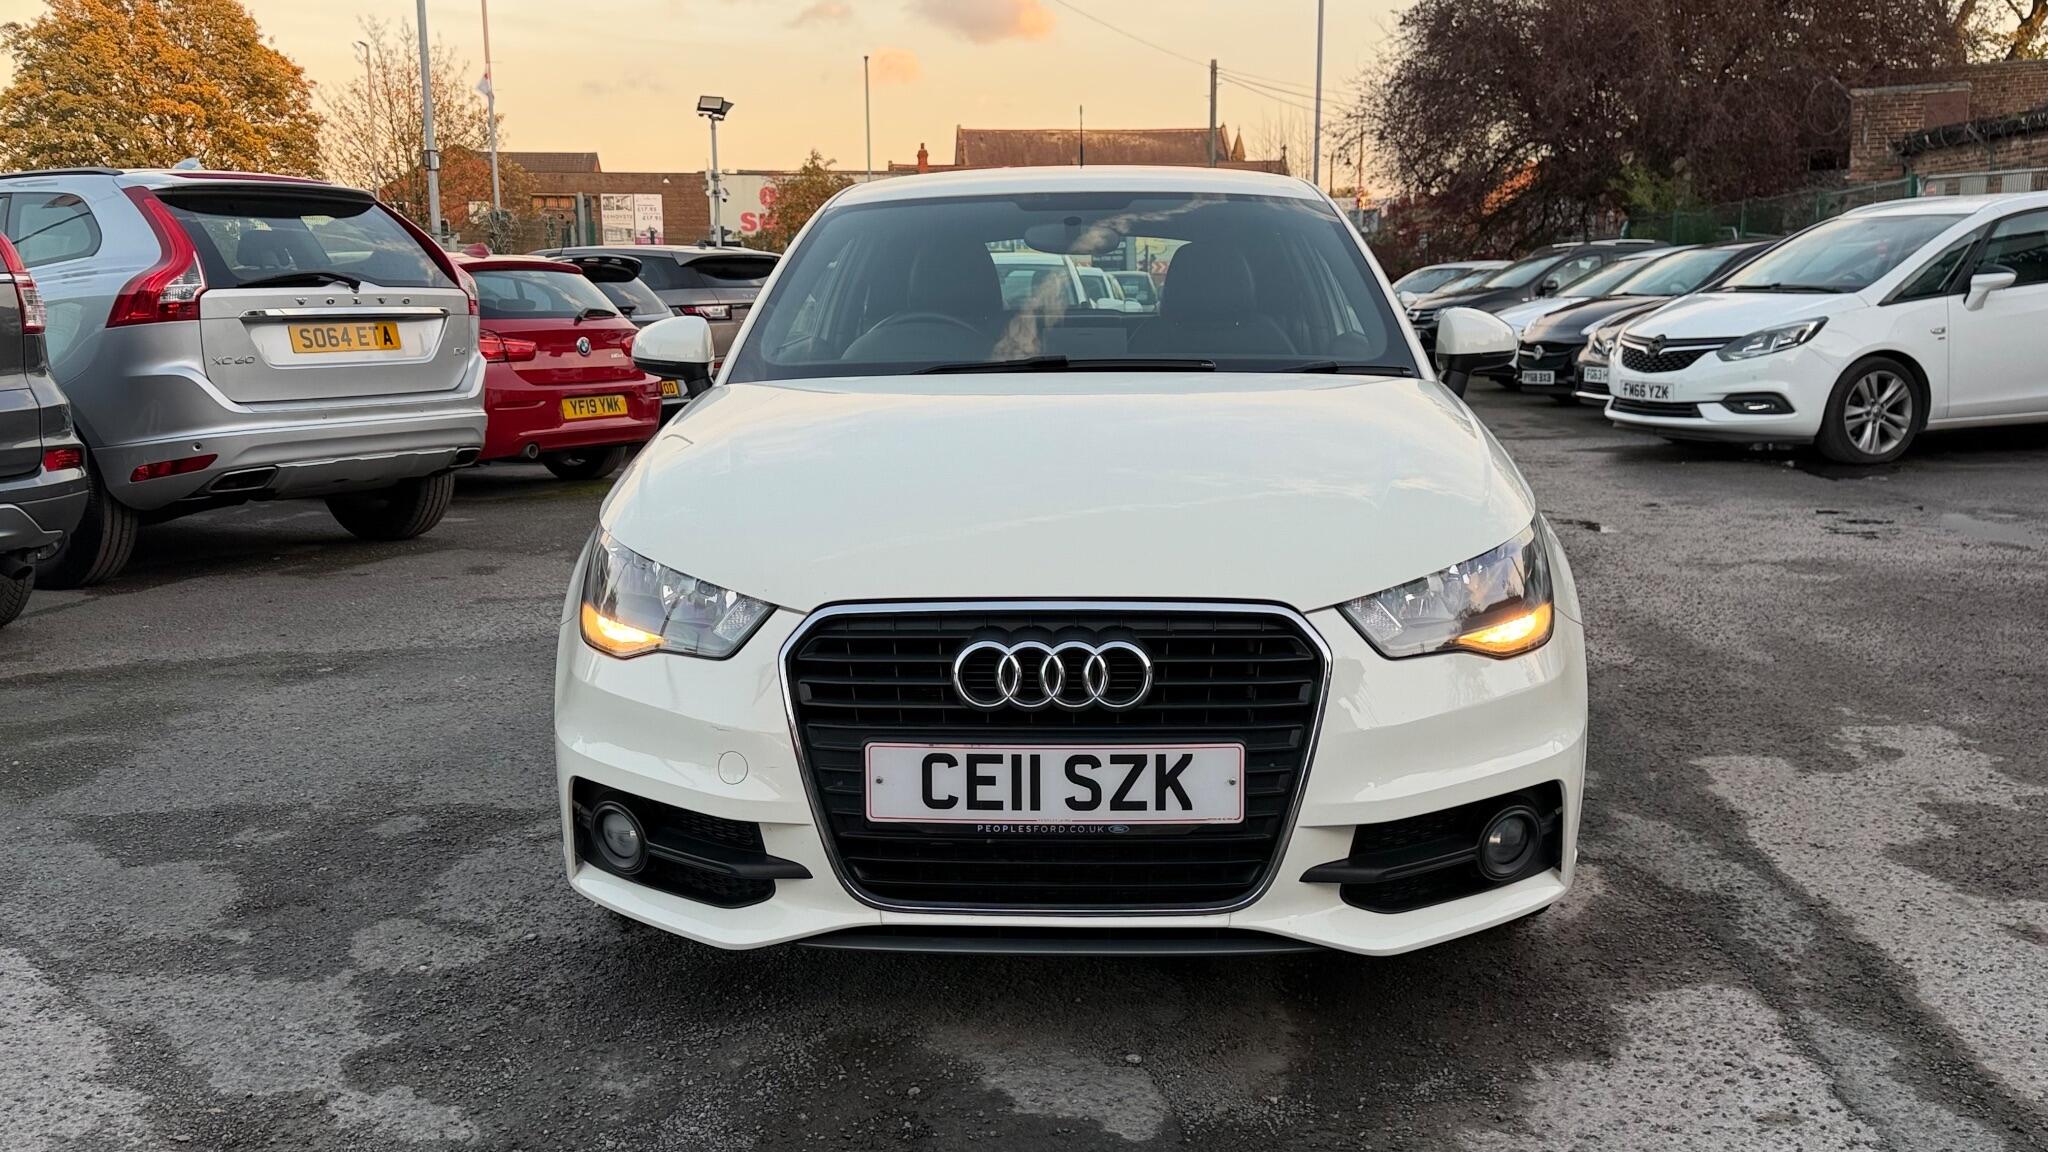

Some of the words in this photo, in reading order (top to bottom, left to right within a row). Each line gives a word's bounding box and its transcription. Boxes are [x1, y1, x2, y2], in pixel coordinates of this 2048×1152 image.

[295, 297, 411, 306] VOLVO
[300, 327, 352, 349] SO64
[358, 324, 394, 347] ETA
[211, 356, 255, 365] XC60
[1623, 382, 1646, 397] FM66
[1648, 384, 1669, 399] YZK
[570, 399, 597, 414] YF19
[598, 397, 621, 413] YMK
[921, 752, 1041, 811] CE11
[1064, 753, 1193, 811] SZK
[977, 824, 1105, 833] PEOPLESFORD.CO.UK
